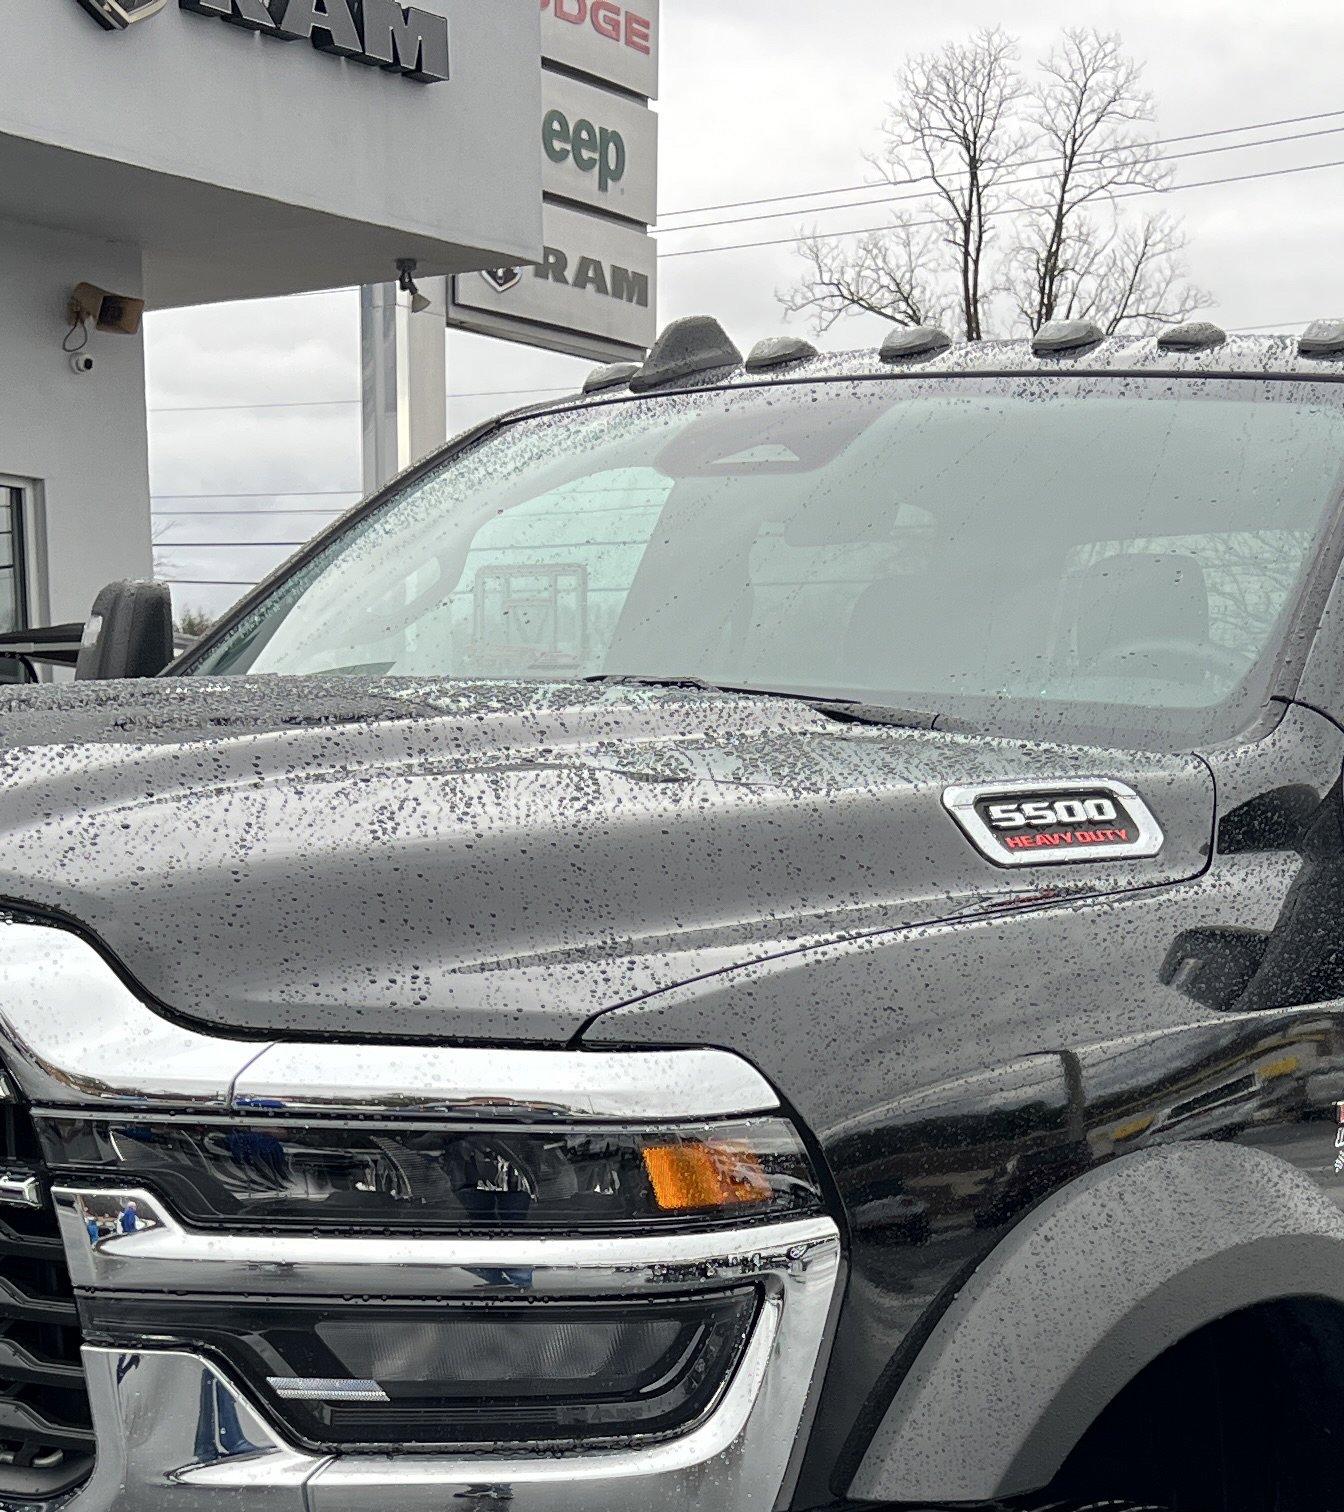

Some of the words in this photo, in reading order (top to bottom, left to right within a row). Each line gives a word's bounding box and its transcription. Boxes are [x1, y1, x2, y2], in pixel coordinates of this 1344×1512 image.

[540, 0, 651, 56] DGE
[542, 108, 625, 192] eep
[534, 246, 649, 308] RAM
[987, 799, 1117, 829] 5500
[1005, 831, 1073, 849] HEAVY
[1074, 828, 1129, 844] DUTY
